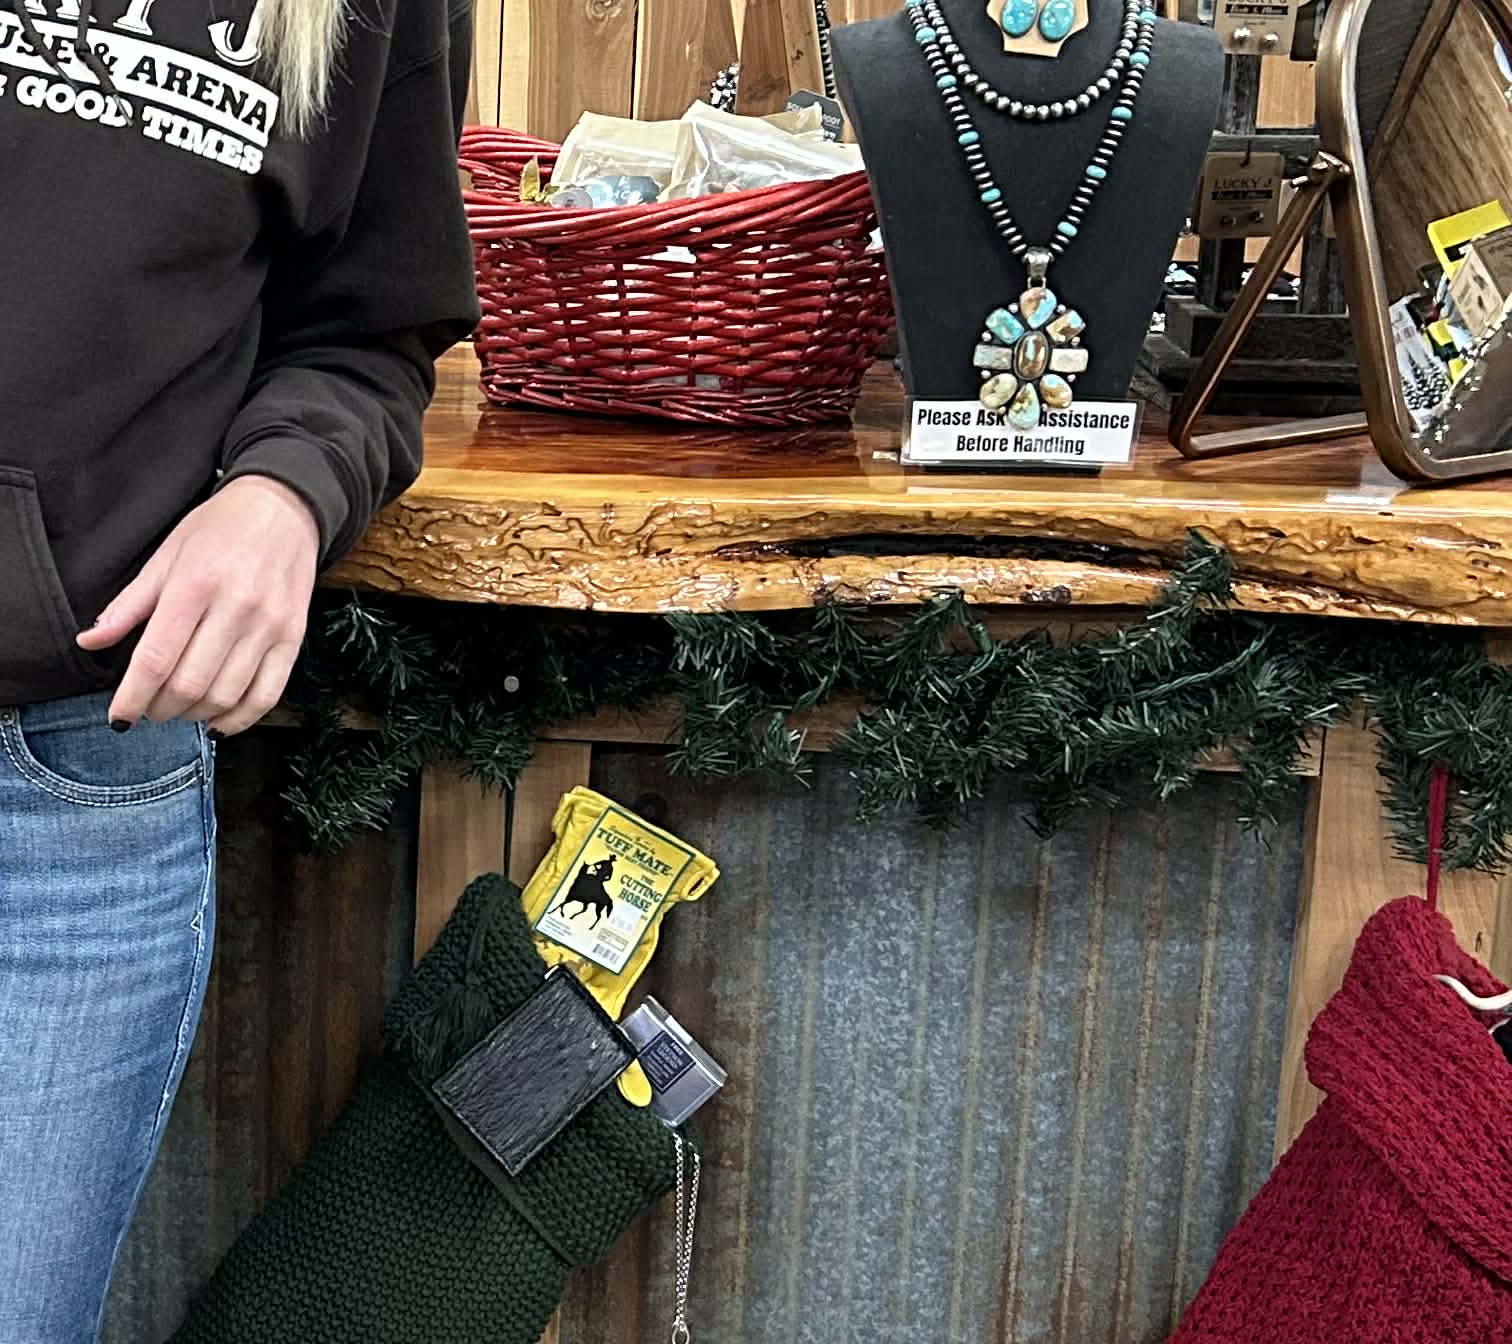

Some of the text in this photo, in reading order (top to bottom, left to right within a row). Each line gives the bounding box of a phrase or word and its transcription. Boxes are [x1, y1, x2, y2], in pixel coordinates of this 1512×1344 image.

[126, 55, 271, 134] ARENA
[16, 75, 135, 128] GOOD
[142, 105, 265, 175] TIMES
[1215, 176, 1261, 189] LUCKY
[918, 408, 1130, 429] Please Ask Assistance
[956, 434, 1086, 456] Before Handling
[597, 827, 633, 854] TUFF
[632, 848, 673, 876] MATE
[618, 887, 652, 913] HORSE
[620, 873, 663, 903] CUTTING
